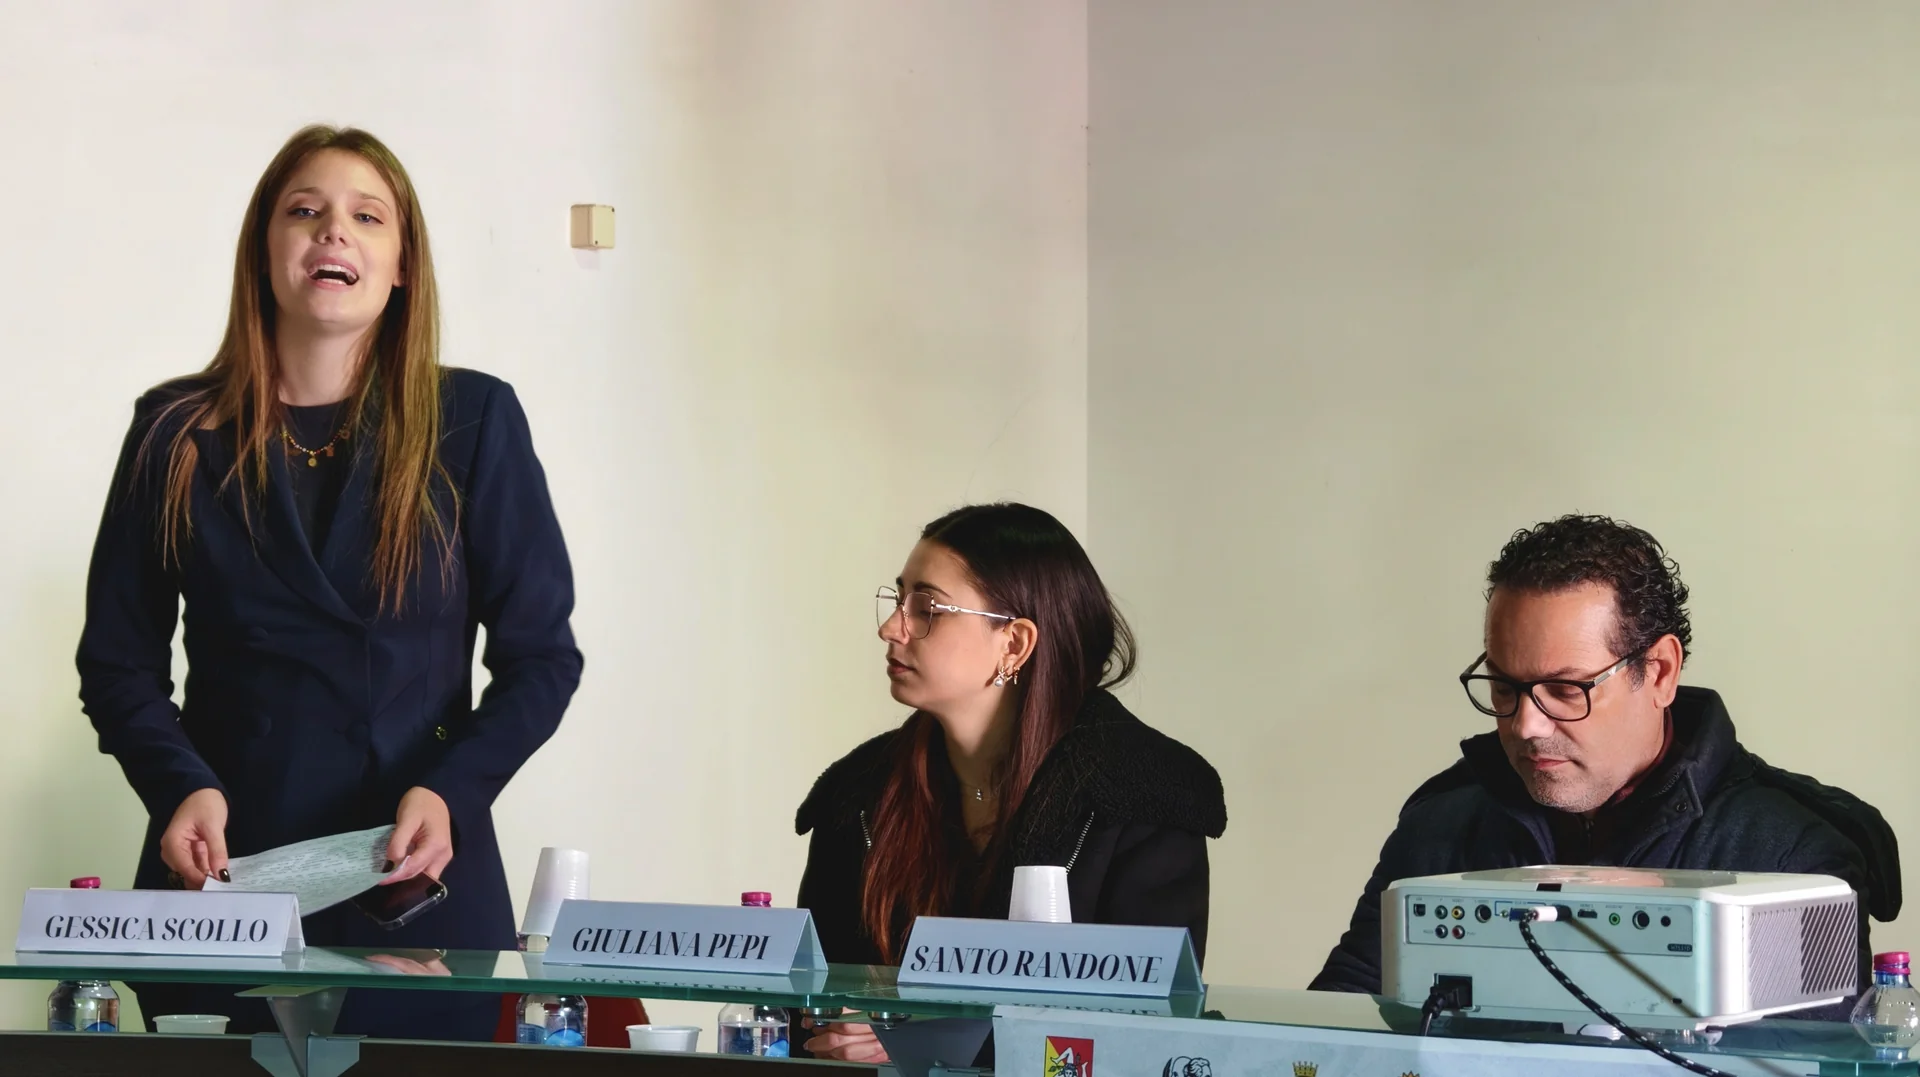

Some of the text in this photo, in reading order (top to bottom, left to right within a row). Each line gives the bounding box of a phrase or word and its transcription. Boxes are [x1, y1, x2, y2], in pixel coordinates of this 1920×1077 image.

[44, 914, 269, 943] GESSICA SCOLLO
[572, 926, 772, 961] GIULIANA PEPI
[909, 944, 1163, 984] SANTO RANDONE
